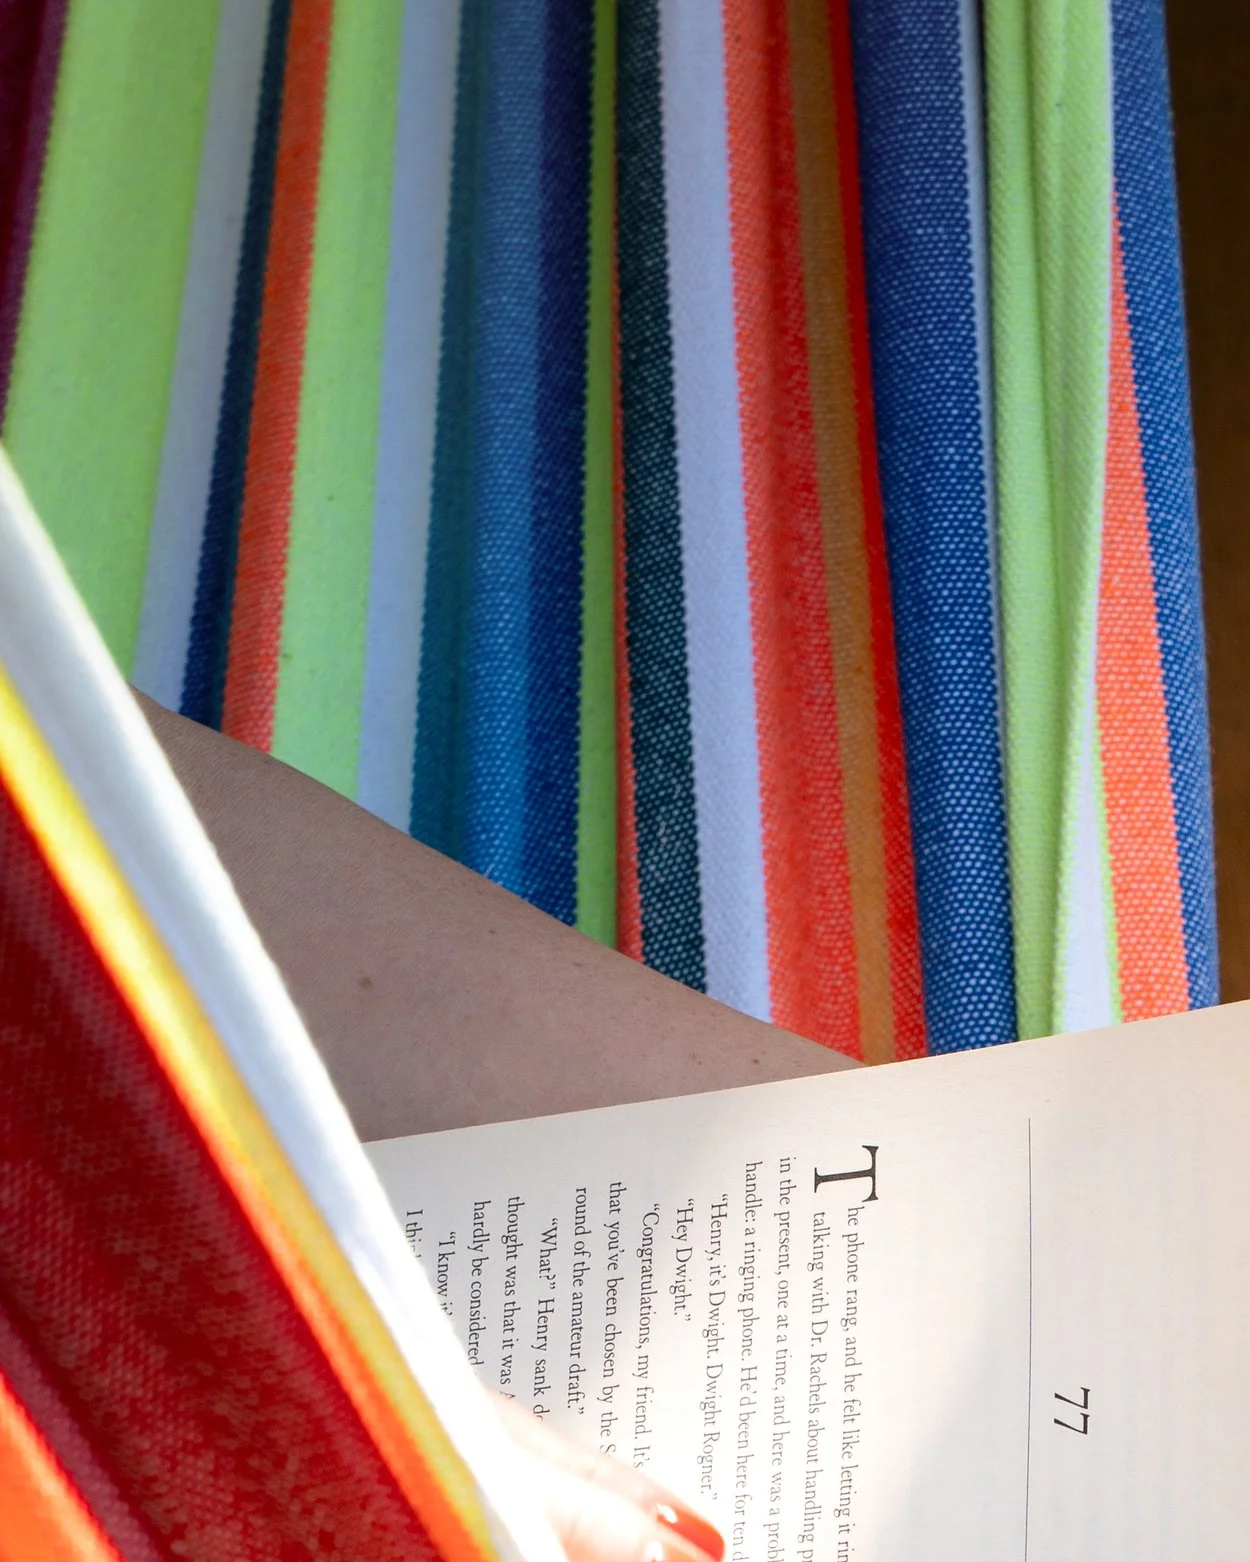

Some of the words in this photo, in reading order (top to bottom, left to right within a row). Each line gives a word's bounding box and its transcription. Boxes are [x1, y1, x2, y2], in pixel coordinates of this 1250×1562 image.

[779, 1156, 797, 1174] in
[608, 1181, 627, 1215] that
[745, 1161, 763, 1223] handle:
[779, 1178, 797, 1206] the
[406, 1209, 423, 1218] I
[467, 1200, 491, 1254] hardly
[501, 1196, 525, 1261] thought
[573, 1187, 592, 1236] round
[603, 1221, 625, 1271] you’ve
[744, 1227, 756, 1236] a
[773, 1210, 791, 1275] present,
[806, 1211, 831, 1273] talking
[573, 1241, 591, 1259] of
[842, 1232, 865, 1283] phone
[437, 1251, 456, 1297] know
[471, 1258, 491, 1277] be
[504, 1265, 516, 1297] was
[571, 1261, 589, 1288] the
[709, 1264, 727, 1287] it’s
[737, 1241, 761, 1303] ringing
[605, 1277, 624, 1317] been
[777, 1280, 789, 1309] one
[811, 1276, 830, 1315] with
[840, 1289, 858, 1332] rang,
[503, 1301, 521, 1334] that
[531, 1298, 555, 1351] Henry
[569, 1292, 584, 1359] amateur
[702, 1290, 726, 1359] Dwight.
[737, 1307, 760, 1361] phone.
[776, 1314, 789, 1330] at
[810, 1319, 829, 1347] Dr.
[502, 1338, 519, 1350] it
[603, 1323, 622, 1379] chosen
[776, 1334, 788, 1344] a
[845, 1337, 863, 1368] and
[500, 1354, 512, 1385] was
[534, 1359, 551, 1396] sank
[632, 1355, 649, 1379] my
[771, 1348, 792, 1391] time,
[808, 1352, 828, 1414] Rachels
[844, 1373, 862, 1393] he
[596, 1384, 620, 1404] by
[699, 1363, 723, 1427] Dwight
[740, 1366, 757, 1406] He’d
[600, 1411, 619, 1437] the
[634, 1386, 654, 1439] friend.
[773, 1396, 791, 1426] and
[843, 1398, 862, 1424] felt
[1053, 1386, 1090, 1436] 77
[738, 1411, 756, 1449] been
[806, 1419, 826, 1465] about
[841, 1429, 861, 1459] like
[772, 1430, 790, 1466] here
[736, 1454, 754, 1488] here
[770, 1471, 782, 1502] was
[735, 1494, 752, 1516] for
[797, 1469, 824, 1544] handling
[833, 1464, 859, 1518] letting
[769, 1508, 780, 1516] a
[838, 1523, 856, 1535] it
[733, 1521, 746, 1546] ten
